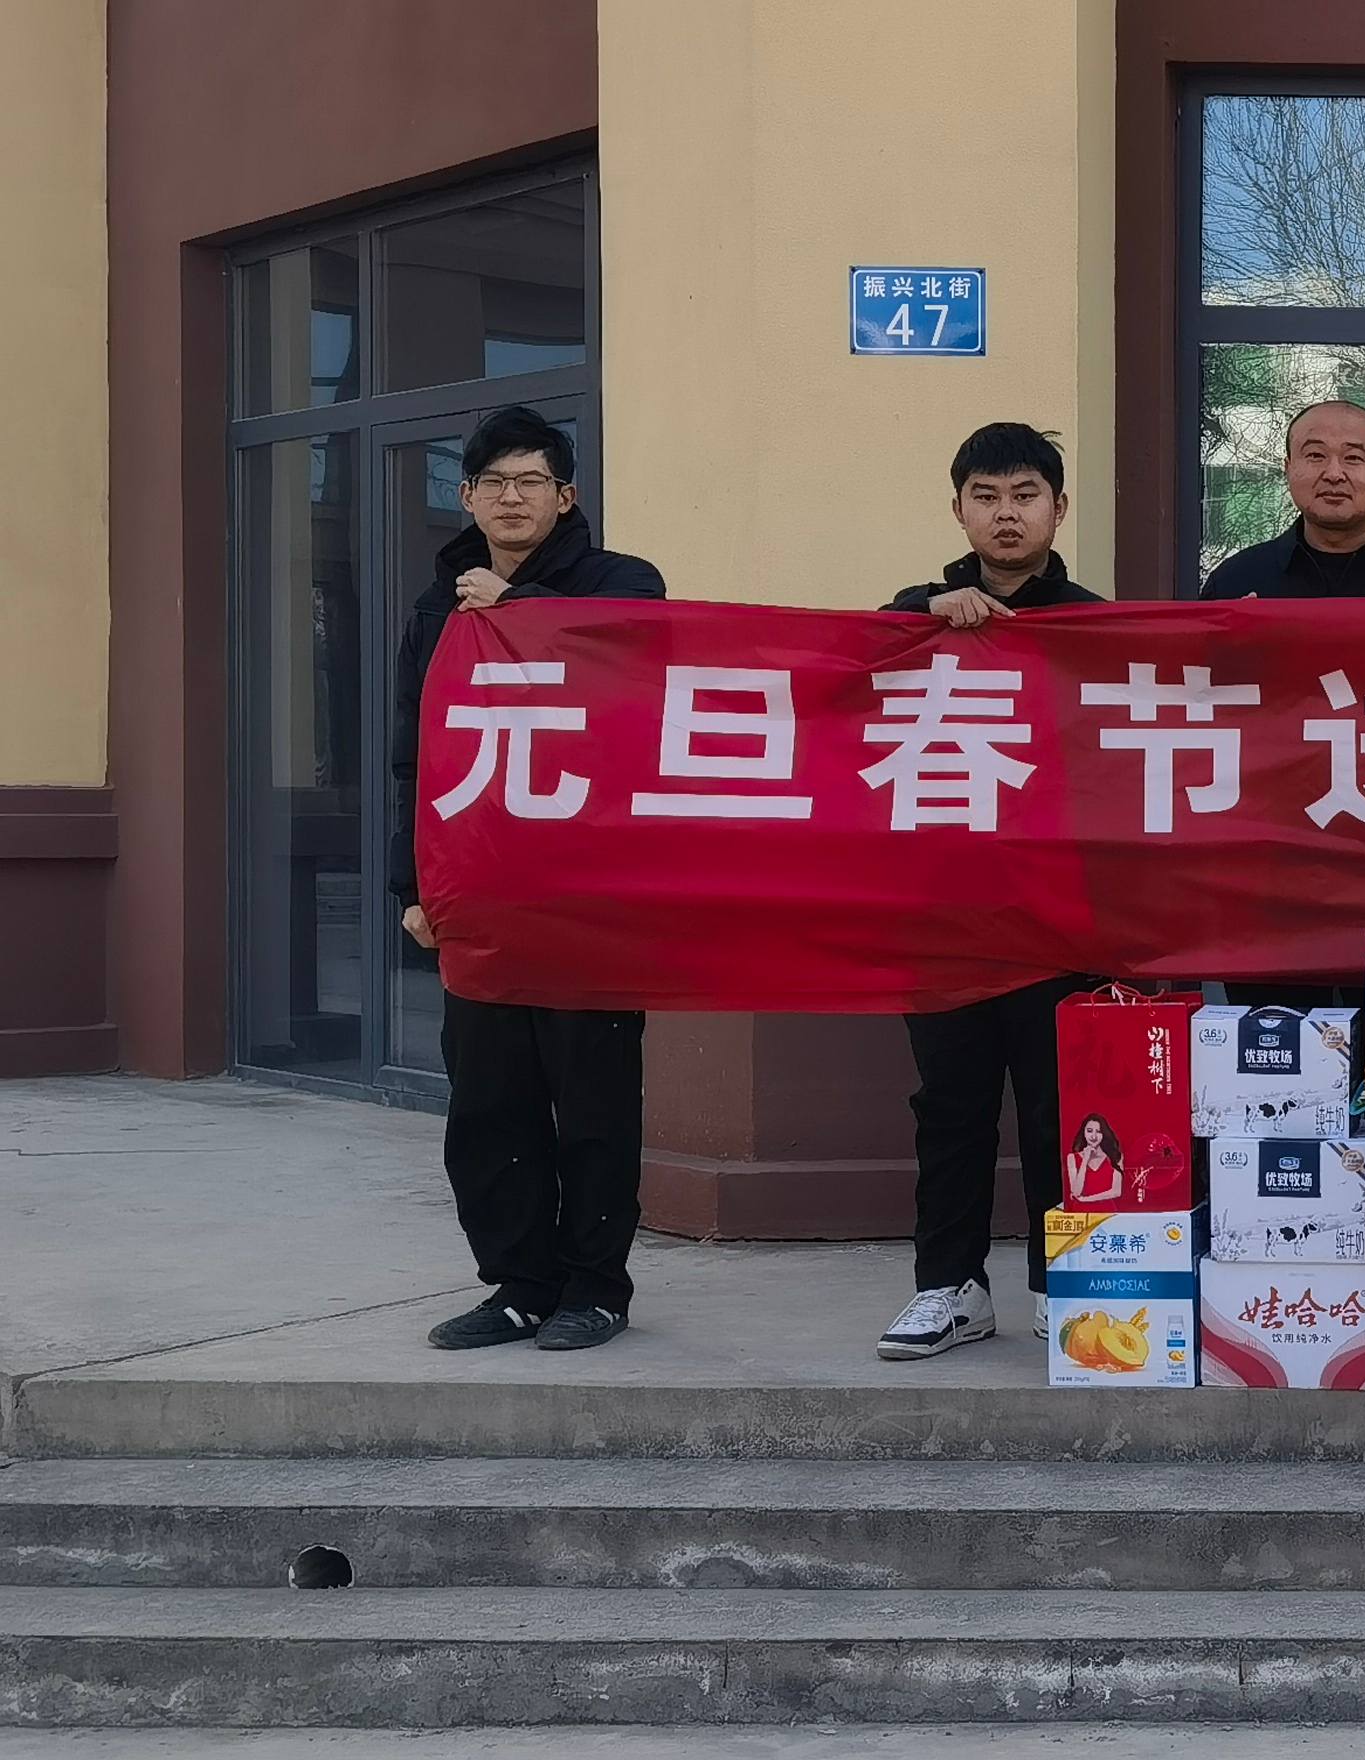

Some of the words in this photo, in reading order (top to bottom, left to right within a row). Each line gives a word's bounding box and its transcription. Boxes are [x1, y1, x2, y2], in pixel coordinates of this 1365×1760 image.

[864, 276, 972, 299] 振兴北街
[886, 303, 949, 346] 47
[1147, 1026, 1165, 1095] 山楂树下
[1244, 1048, 1293, 1064] 优致牧场
[1315, 1105, 1345, 1136] 纯牛奶
[1265, 1171, 1313, 1187] 优致牧场
[1089, 1233, 1147, 1254] 安慕希
[1335, 1228, 1365, 1256] 纯牛奶
[1271, 1332, 1332, 1344] 饮用纯净水
